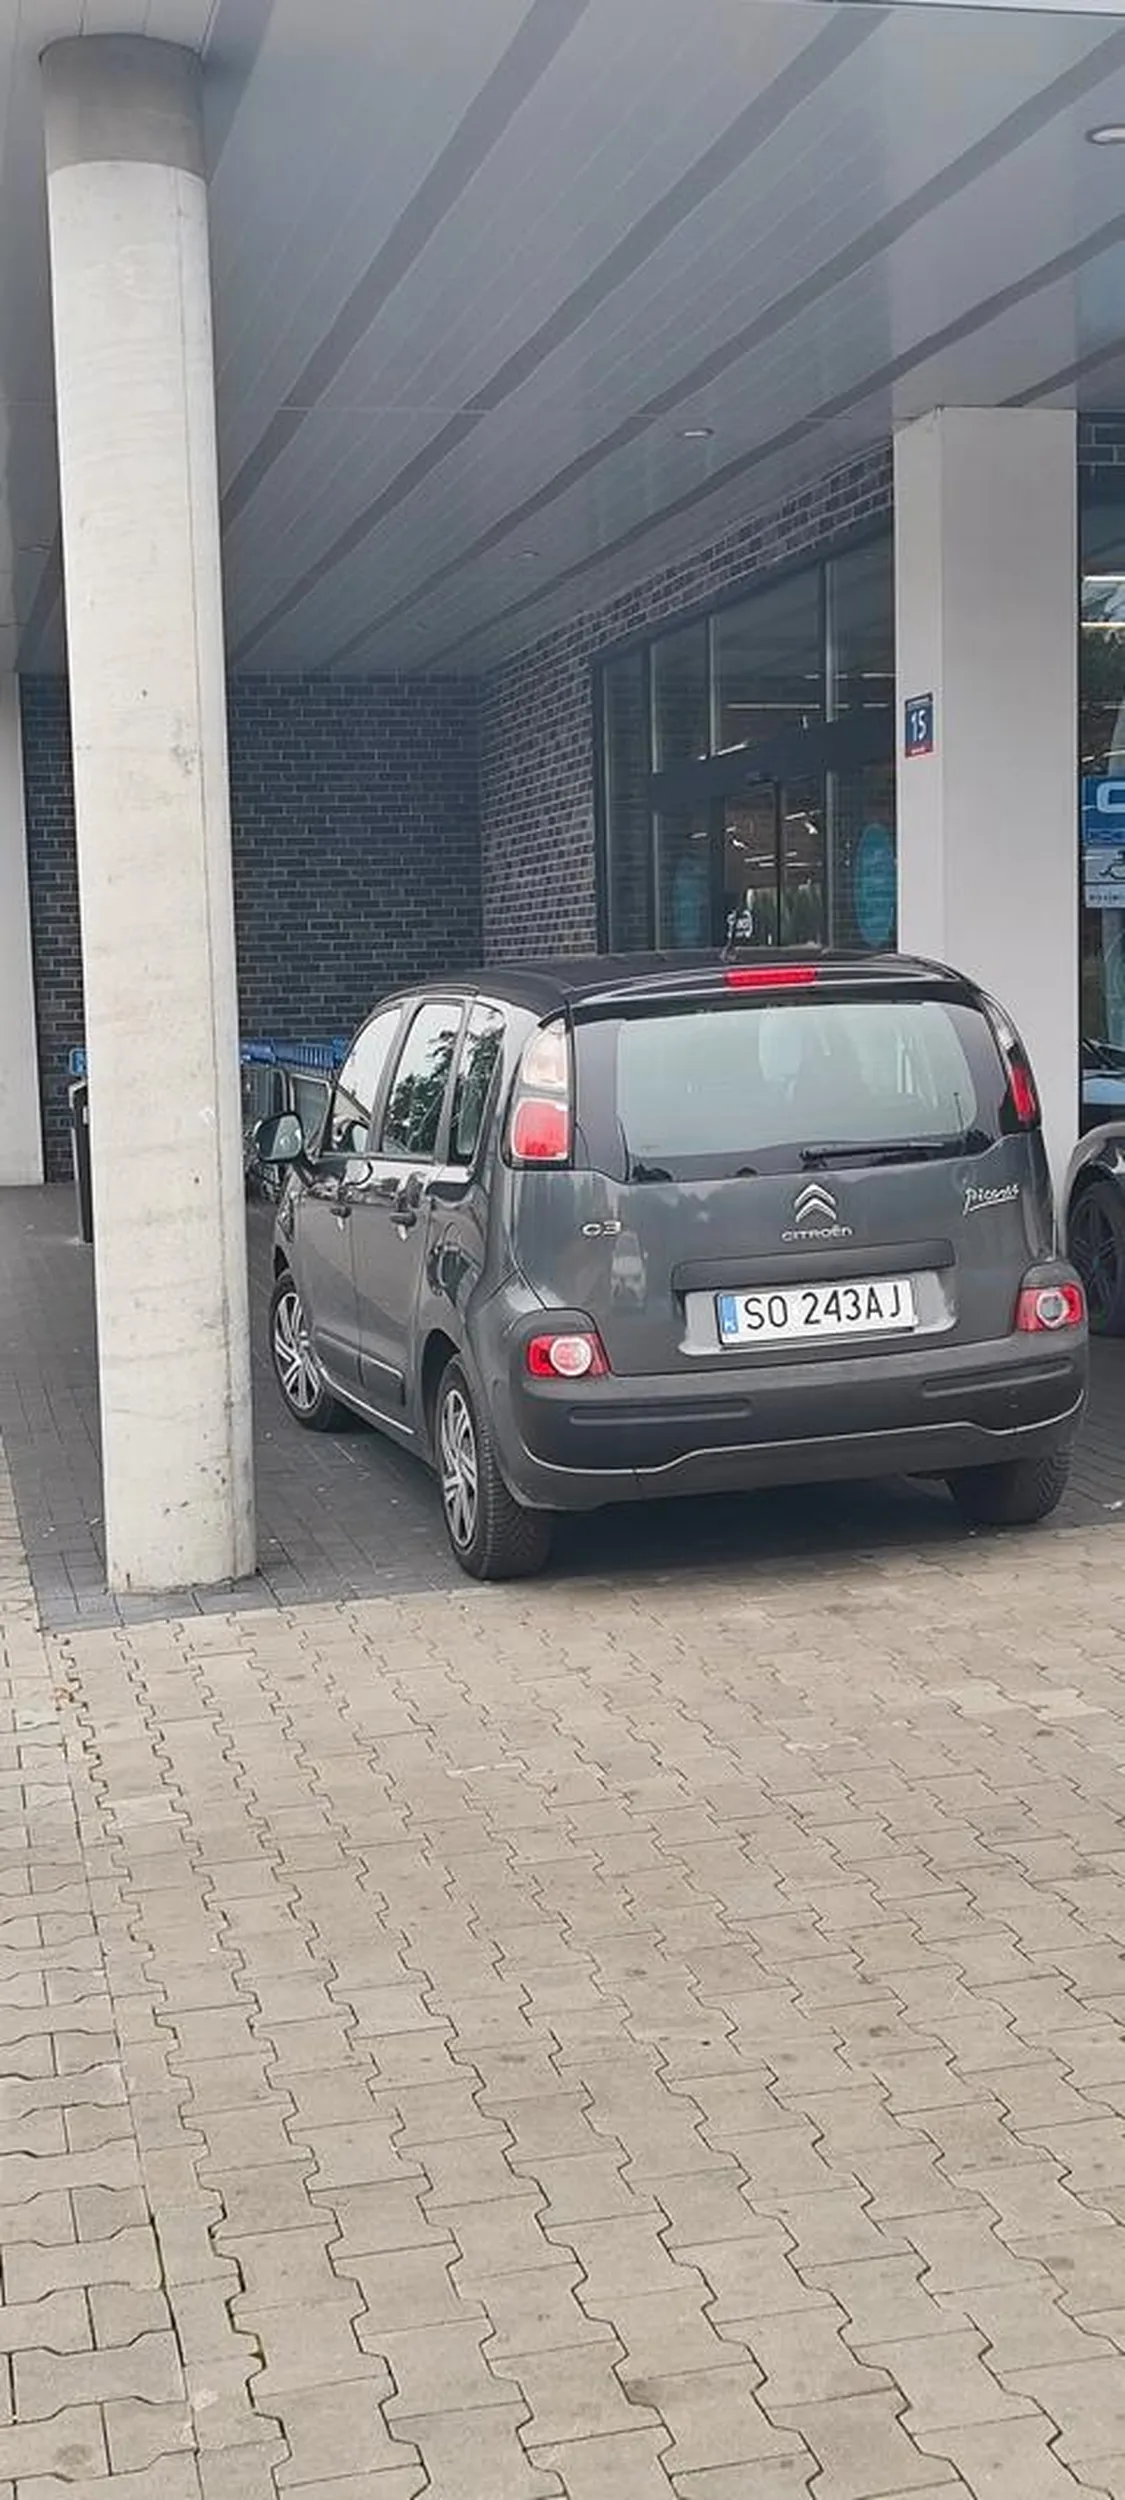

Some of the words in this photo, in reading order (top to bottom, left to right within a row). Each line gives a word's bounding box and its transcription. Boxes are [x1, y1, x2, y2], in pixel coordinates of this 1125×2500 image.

[911, 709, 927, 741] 15
[582, 1220, 621, 1237] C3
[743, 1295, 789, 1331] SO
[801, 1284, 902, 1326] 243AJ
